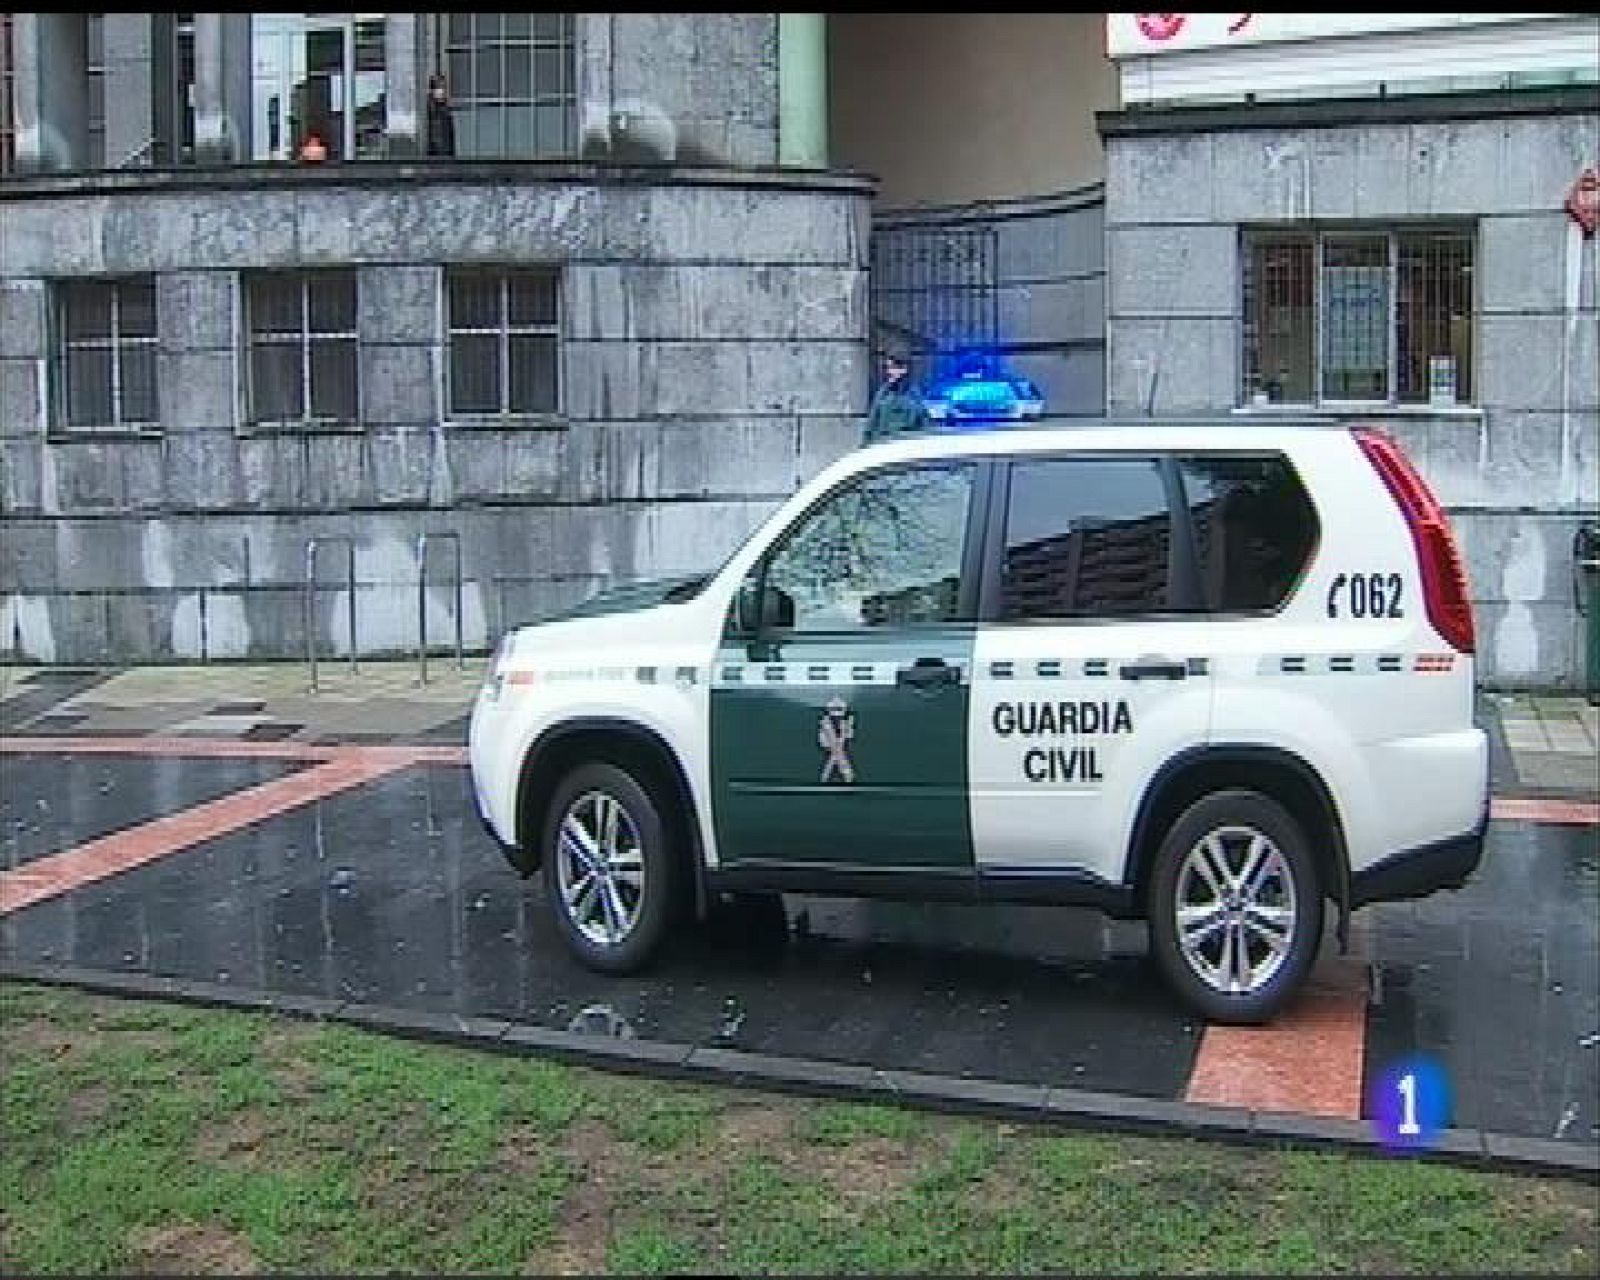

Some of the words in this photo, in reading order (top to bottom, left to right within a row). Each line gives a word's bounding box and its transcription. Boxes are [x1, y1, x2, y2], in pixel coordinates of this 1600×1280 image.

[1350, 573, 1403, 618] 062
[993, 701, 1133, 737] GUARDIA
[1024, 747, 1103, 782] CIVIL
